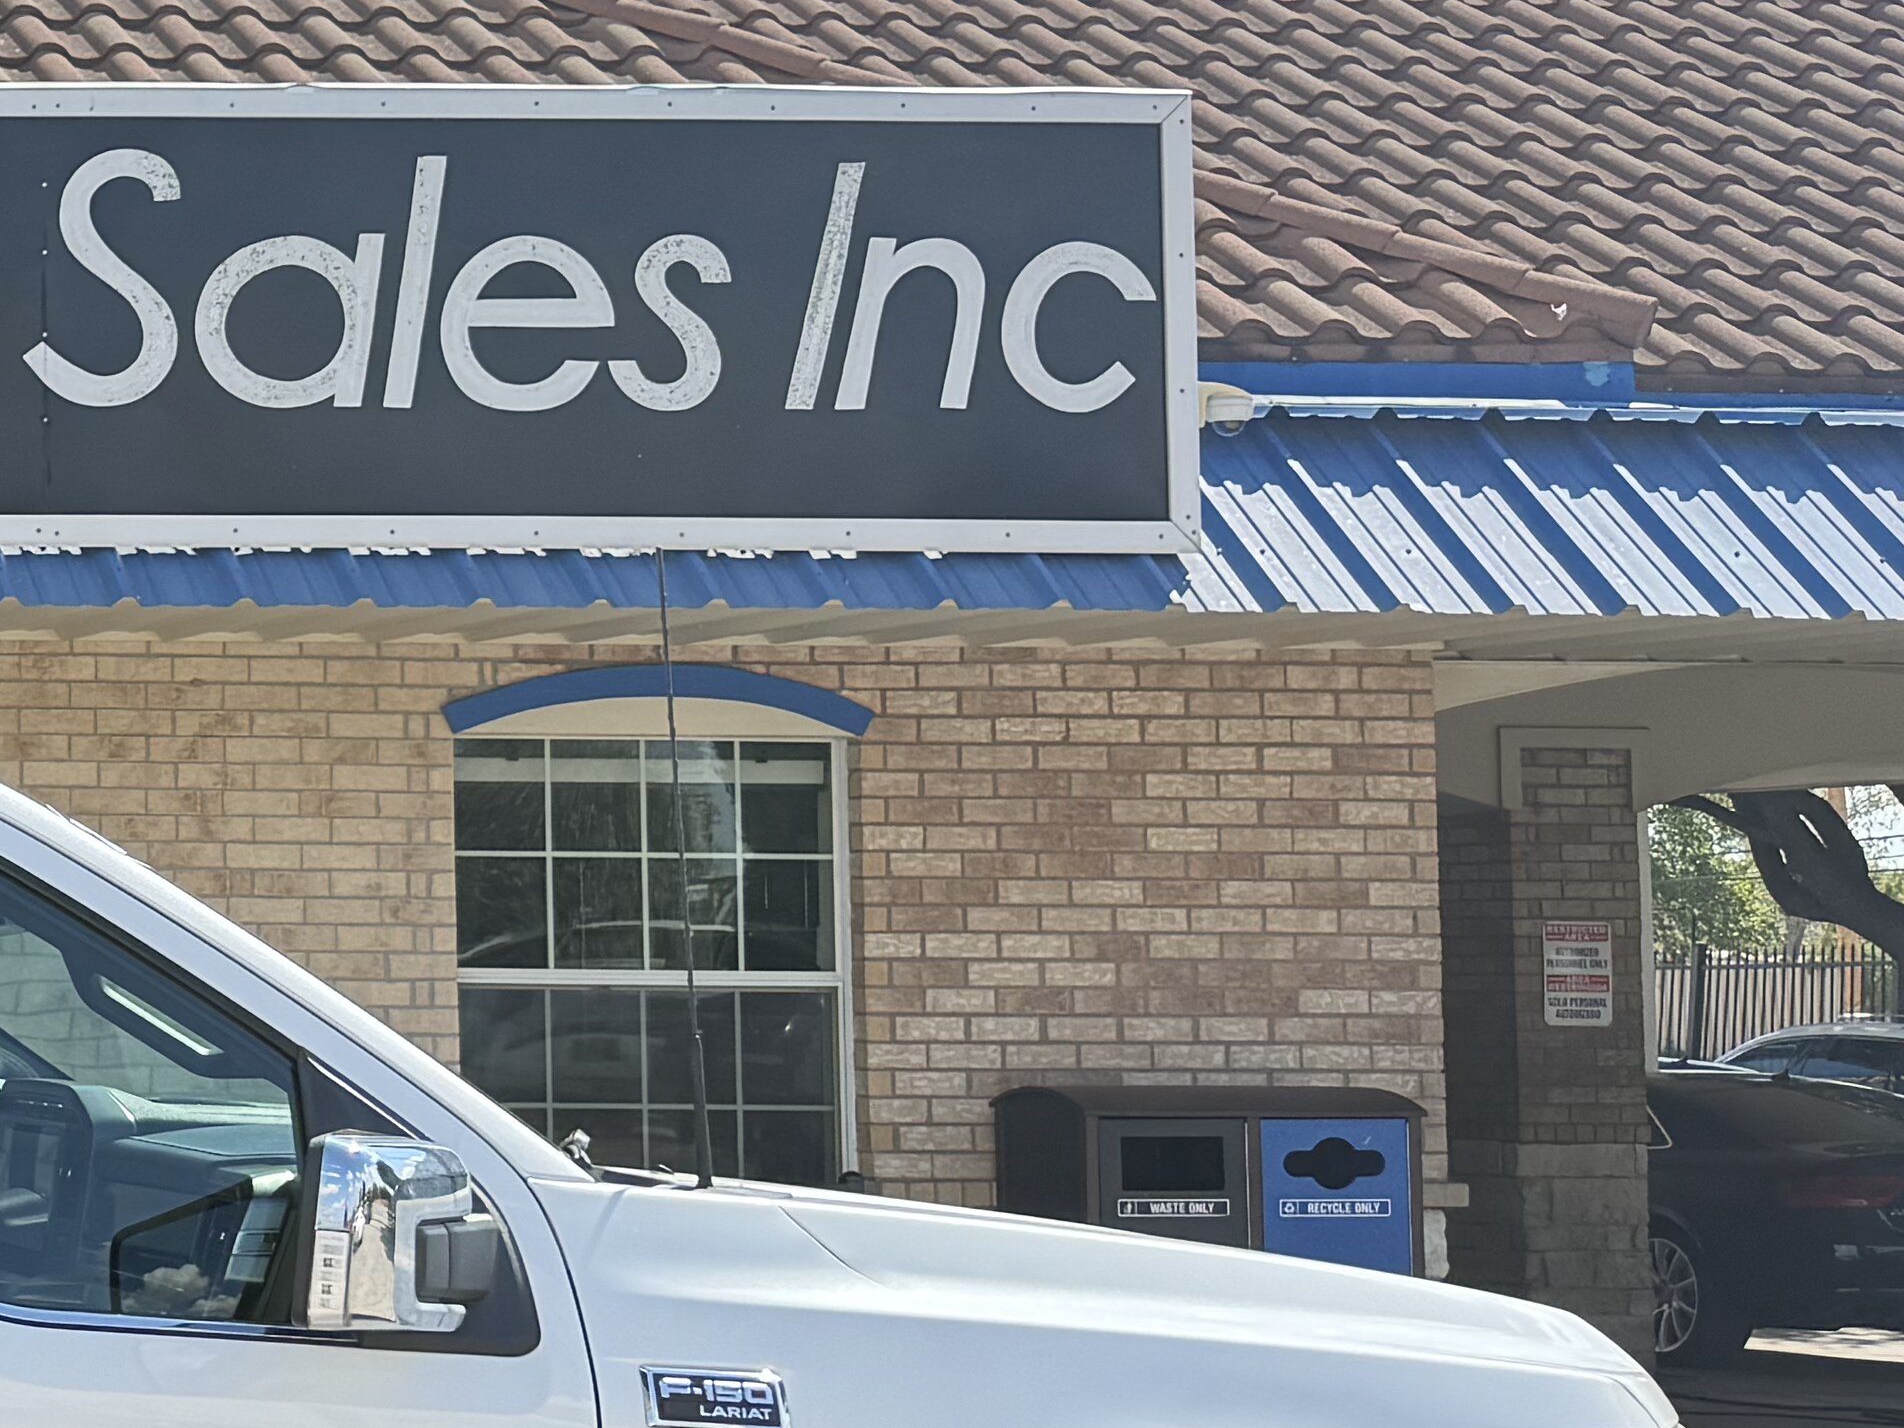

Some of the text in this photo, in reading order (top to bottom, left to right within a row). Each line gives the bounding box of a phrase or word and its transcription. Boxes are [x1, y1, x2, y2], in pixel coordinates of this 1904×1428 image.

[22, 147, 733, 412] Sales
[784, 161, 1158, 414] Inc
[1149, 1202, 1216, 1215] WASTE ONLY
[1307, 1202, 1381, 1215] RECYCLE ONLY
[658, 1376, 774, 1404] F-150
[699, 1404, 773, 1421] LARIAT
